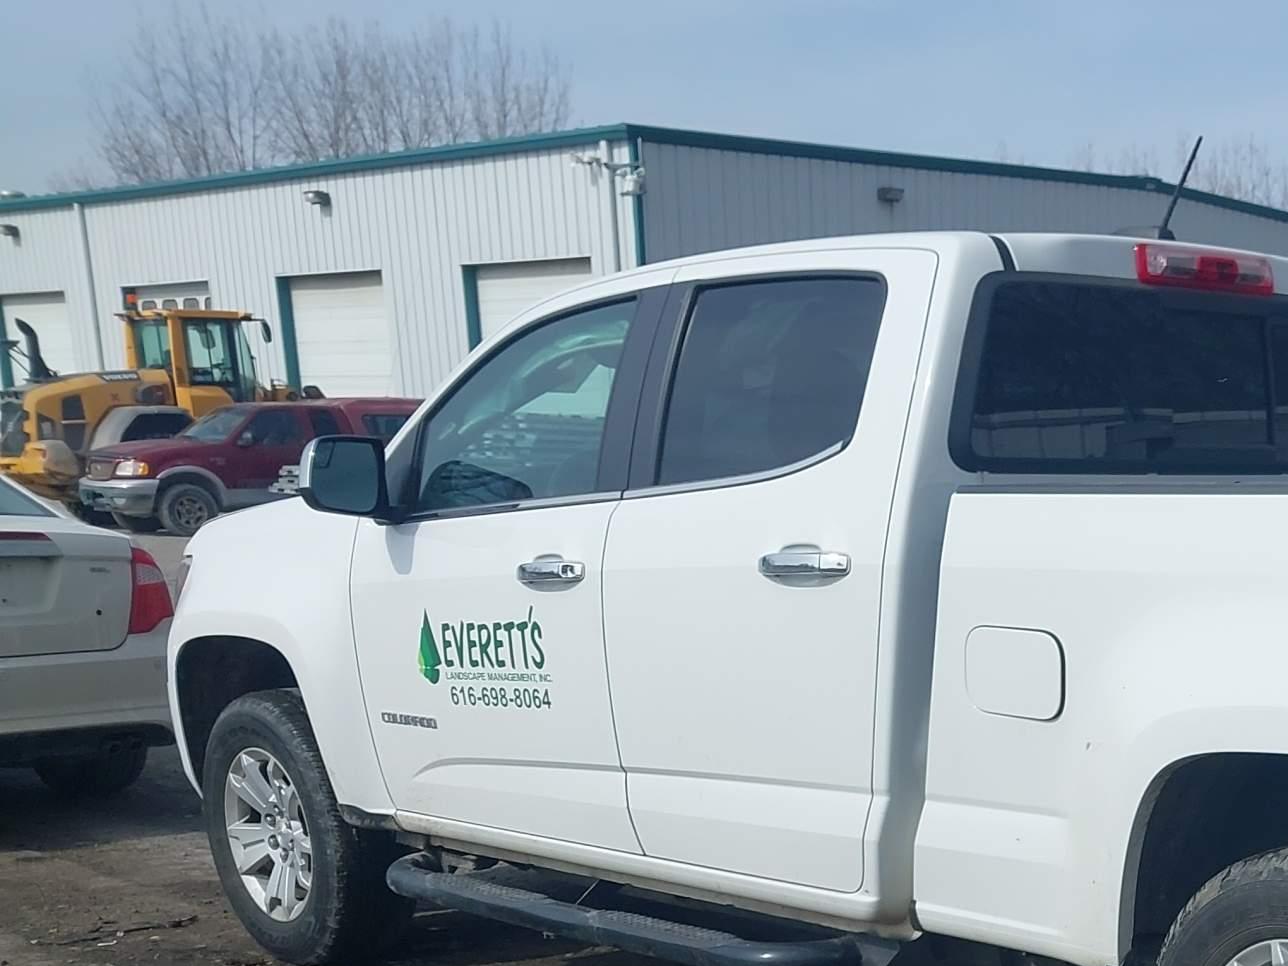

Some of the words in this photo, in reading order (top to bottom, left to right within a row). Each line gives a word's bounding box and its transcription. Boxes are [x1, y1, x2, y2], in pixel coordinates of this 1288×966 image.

[441, 606, 545, 669] EVERETT'S
[446, 672, 486, 681] LANDSCAPE
[451, 686, 552, 709] 616-698-8064
